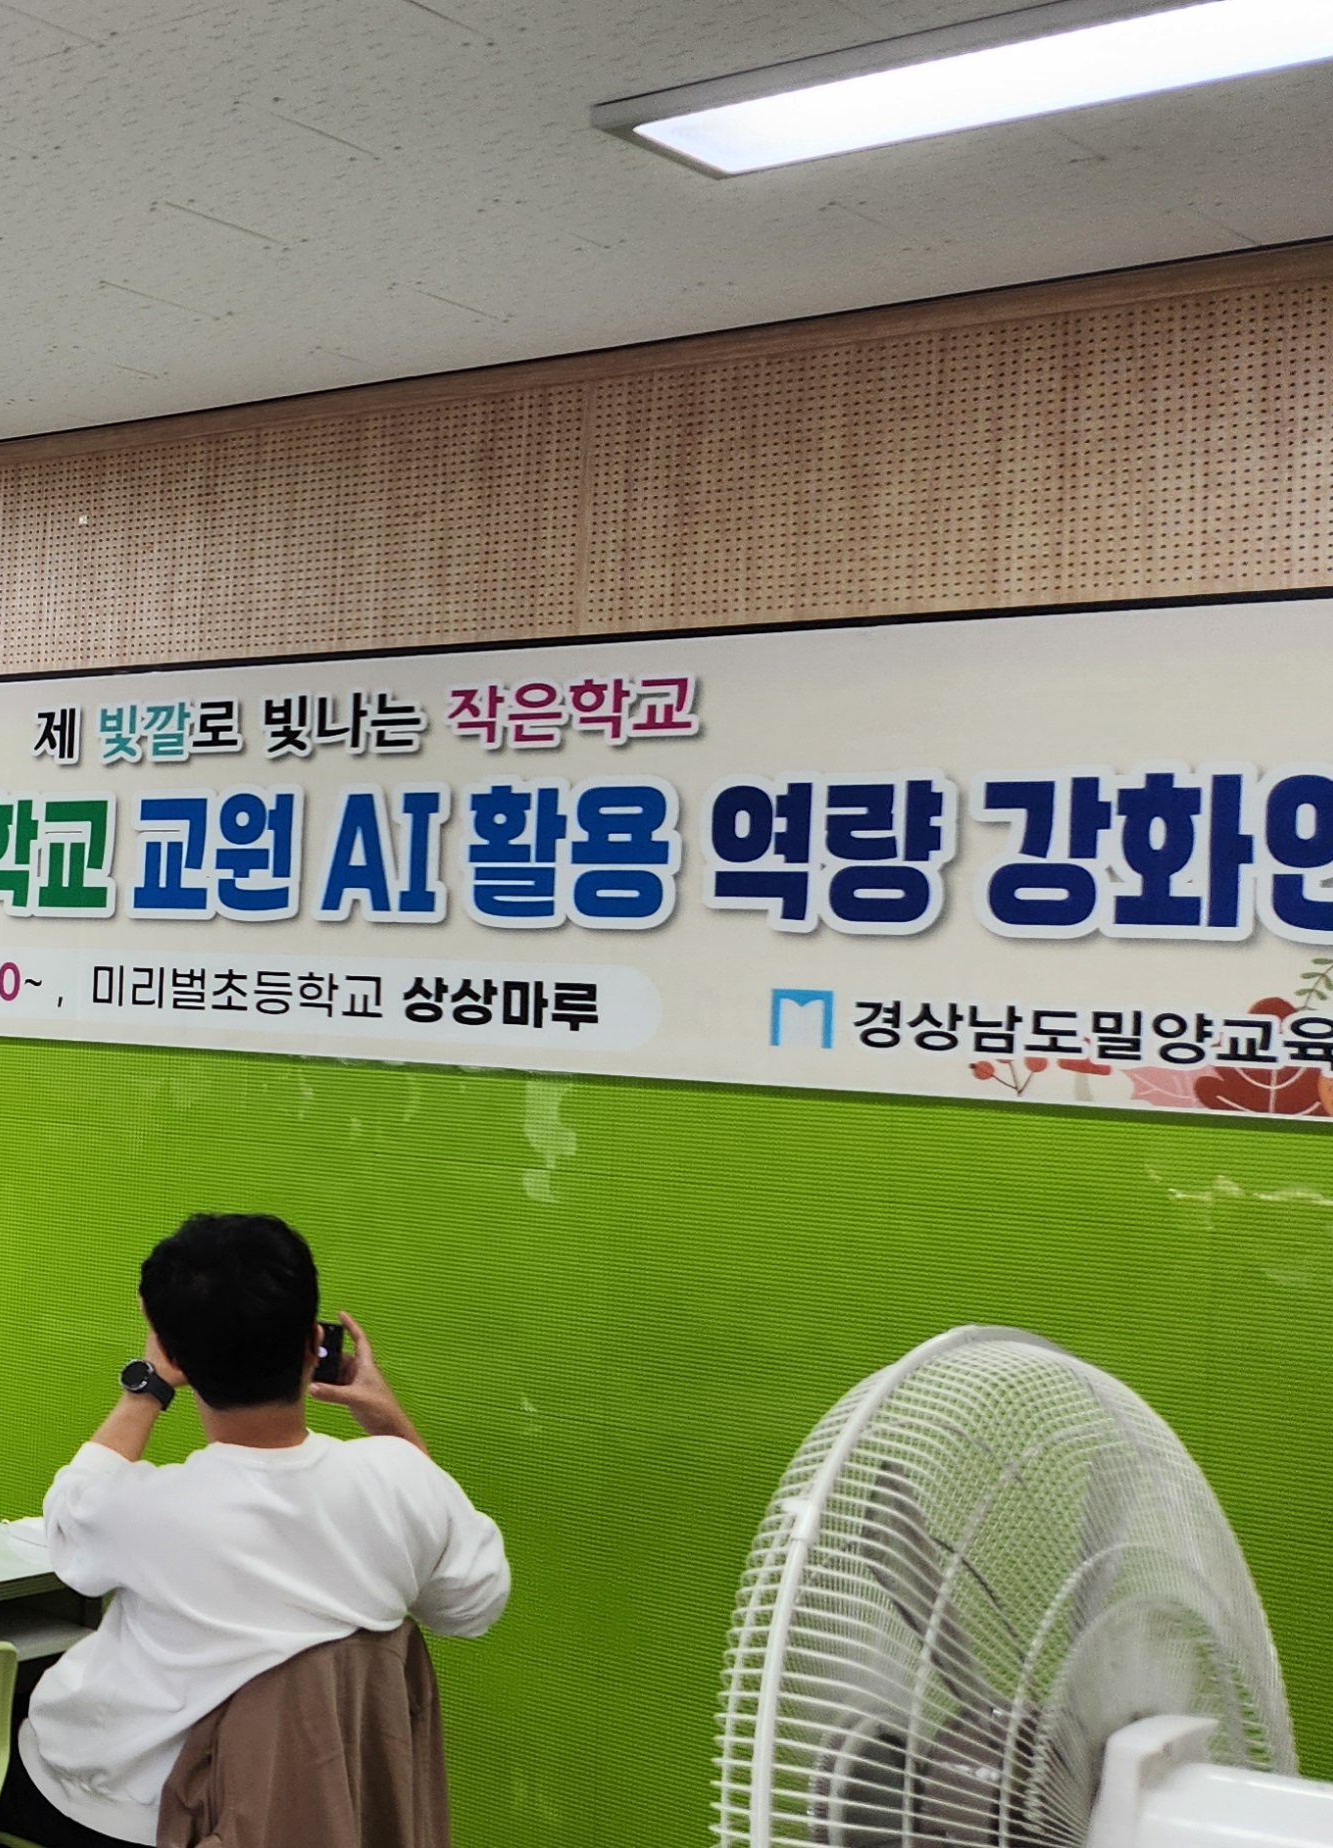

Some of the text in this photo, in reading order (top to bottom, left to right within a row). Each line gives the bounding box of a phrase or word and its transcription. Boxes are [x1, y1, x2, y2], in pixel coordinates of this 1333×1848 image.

[34, 676, 694, 760] 제 빛깔로 빛나는 작은학교
[134, 793, 290, 912] 교원
[323, 791, 440, 913] AI
[467, 785, 670, 919] 활용
[711, 780, 942, 924] 역량
[92, 964, 383, 1020] 미리벌초등학교
[403, 975, 599, 1034] 상상마루
